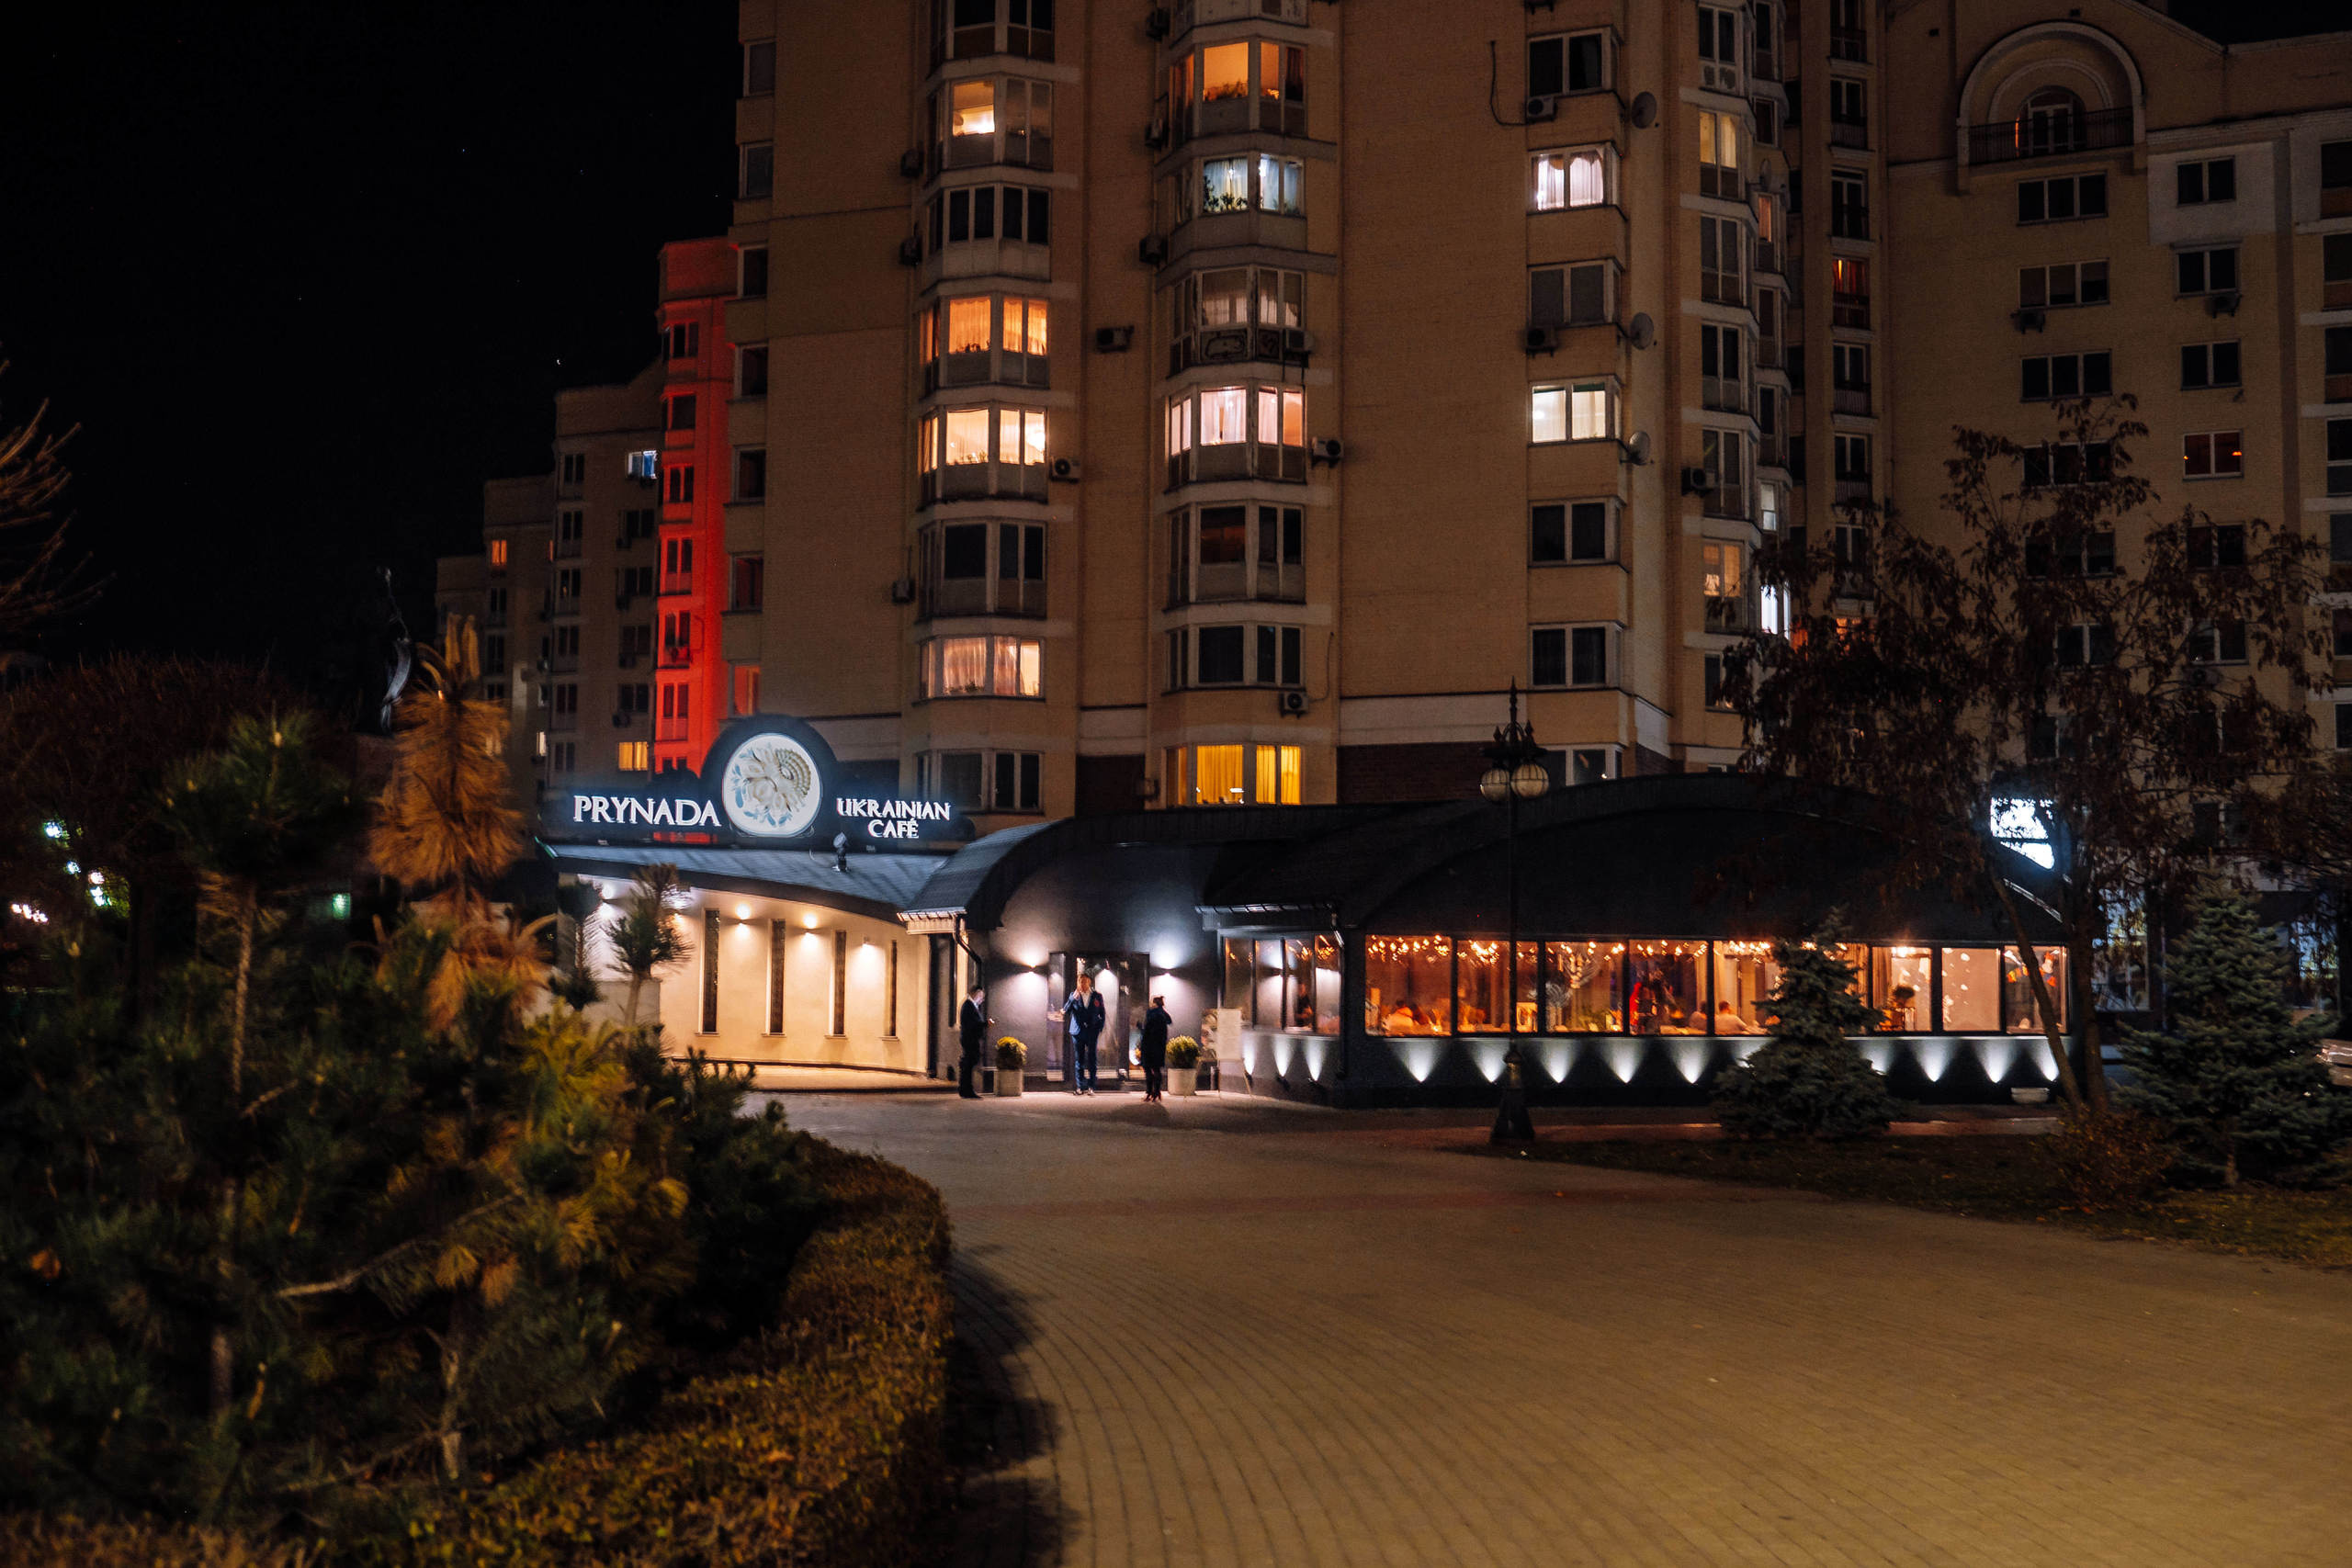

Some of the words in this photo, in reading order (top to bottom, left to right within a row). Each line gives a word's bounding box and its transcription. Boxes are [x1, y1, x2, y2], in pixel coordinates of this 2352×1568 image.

[573, 795, 721, 827] PRYNADA
[837, 798, 951, 820] UKRAINIAN
[868, 818, 919, 838] CAFÉ
